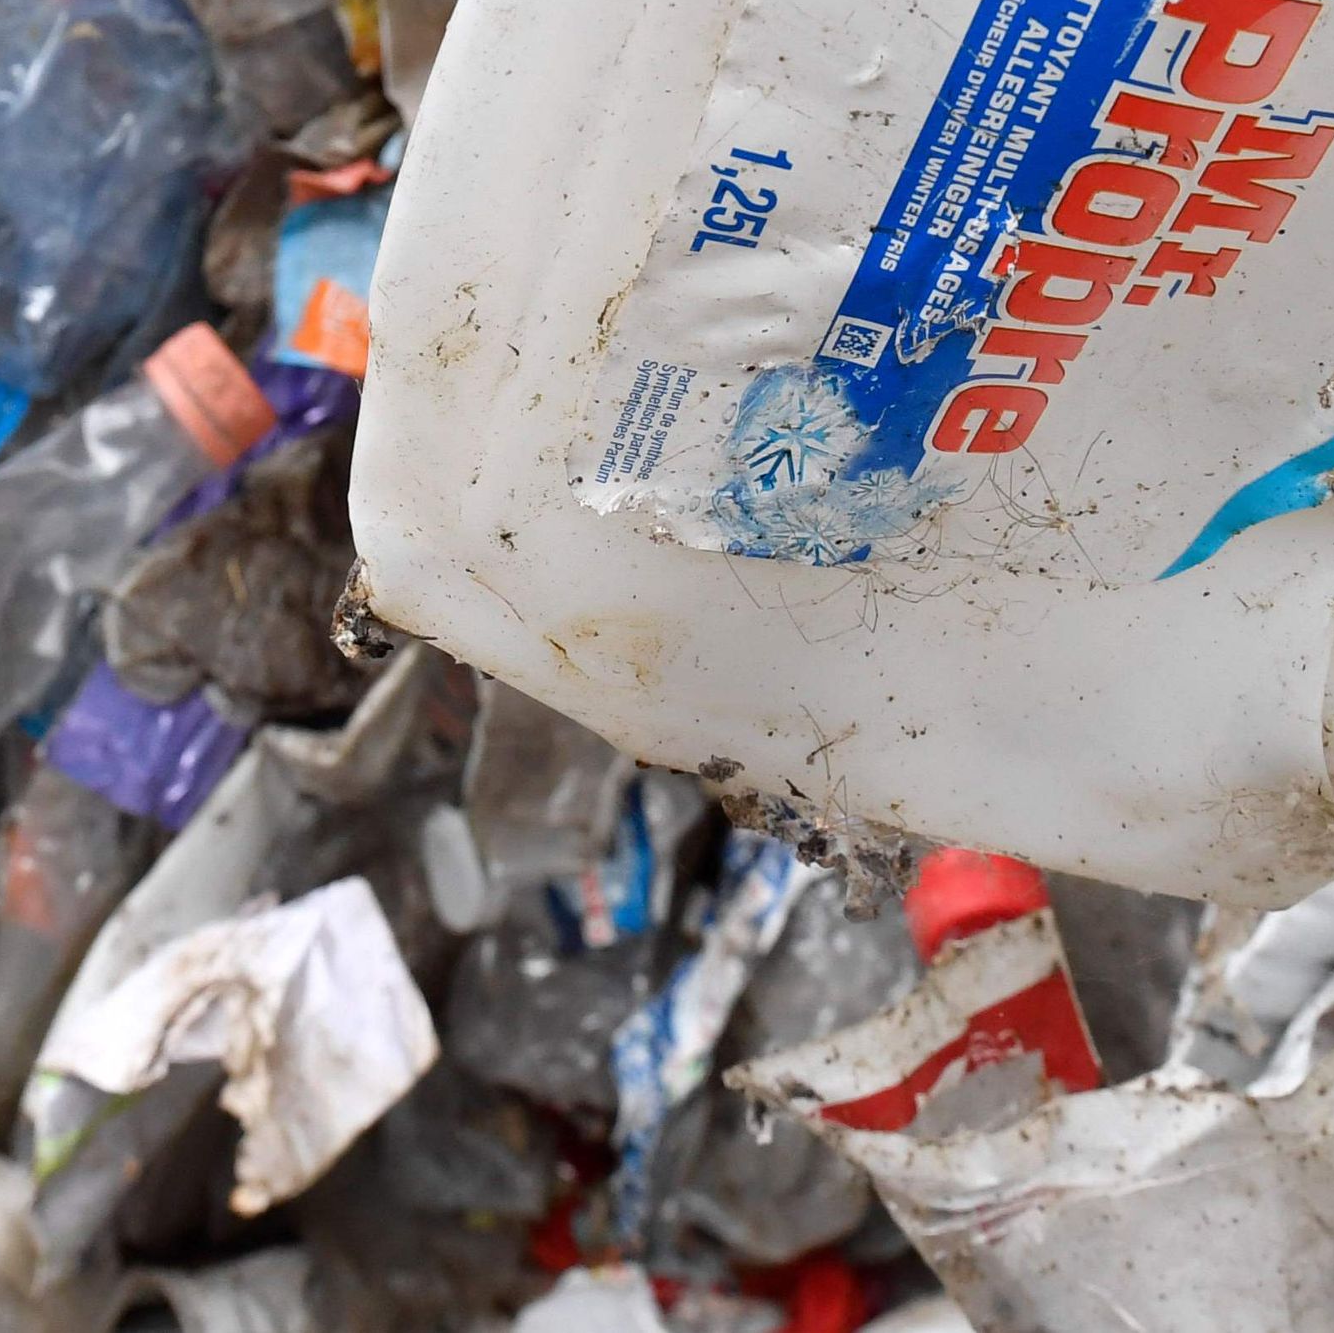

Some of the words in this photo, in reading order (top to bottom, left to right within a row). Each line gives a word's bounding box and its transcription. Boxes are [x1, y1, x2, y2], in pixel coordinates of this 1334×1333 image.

[927, 18, 1050, 239] ALLESREINIGER
[938, 69, 987, 145] D'HIVER
[689, 147, 793, 252] 1,25L
[899, 157, 946, 228] WINTER
[880, 228, 911, 272] FRIS
[613, 359, 658, 440] Synthetisches
[636, 363, 678, 431] Synthetisch
[668, 368, 698, 410] Parfum
[659, 413, 677, 428] de
[595, 441, 625, 483] Parfüm
[619, 432, 645, 474] parfum
[637, 429, 668, 480] synthèse
